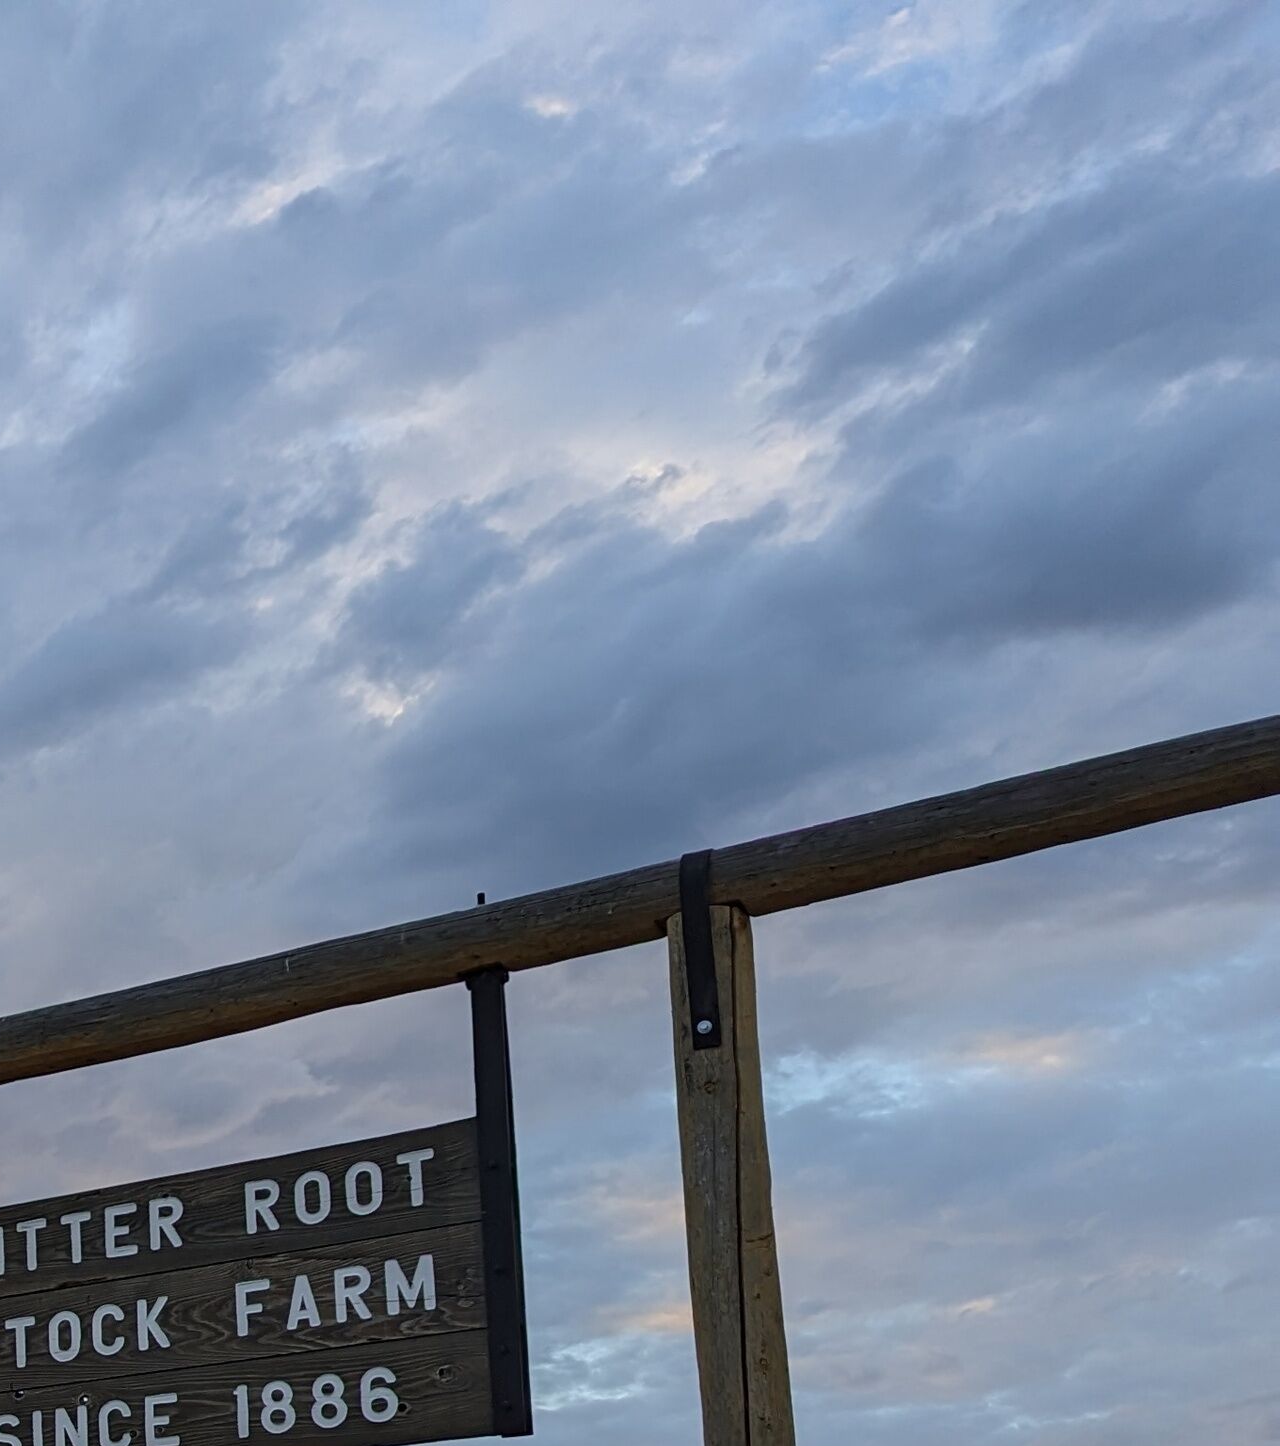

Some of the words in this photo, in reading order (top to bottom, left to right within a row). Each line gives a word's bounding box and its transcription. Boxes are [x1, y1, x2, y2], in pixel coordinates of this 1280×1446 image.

[244, 1148, 435, 1235] ROOT
[235, 1254, 437, 1337] FARM
[232, 1366, 399, 1439] 1886
